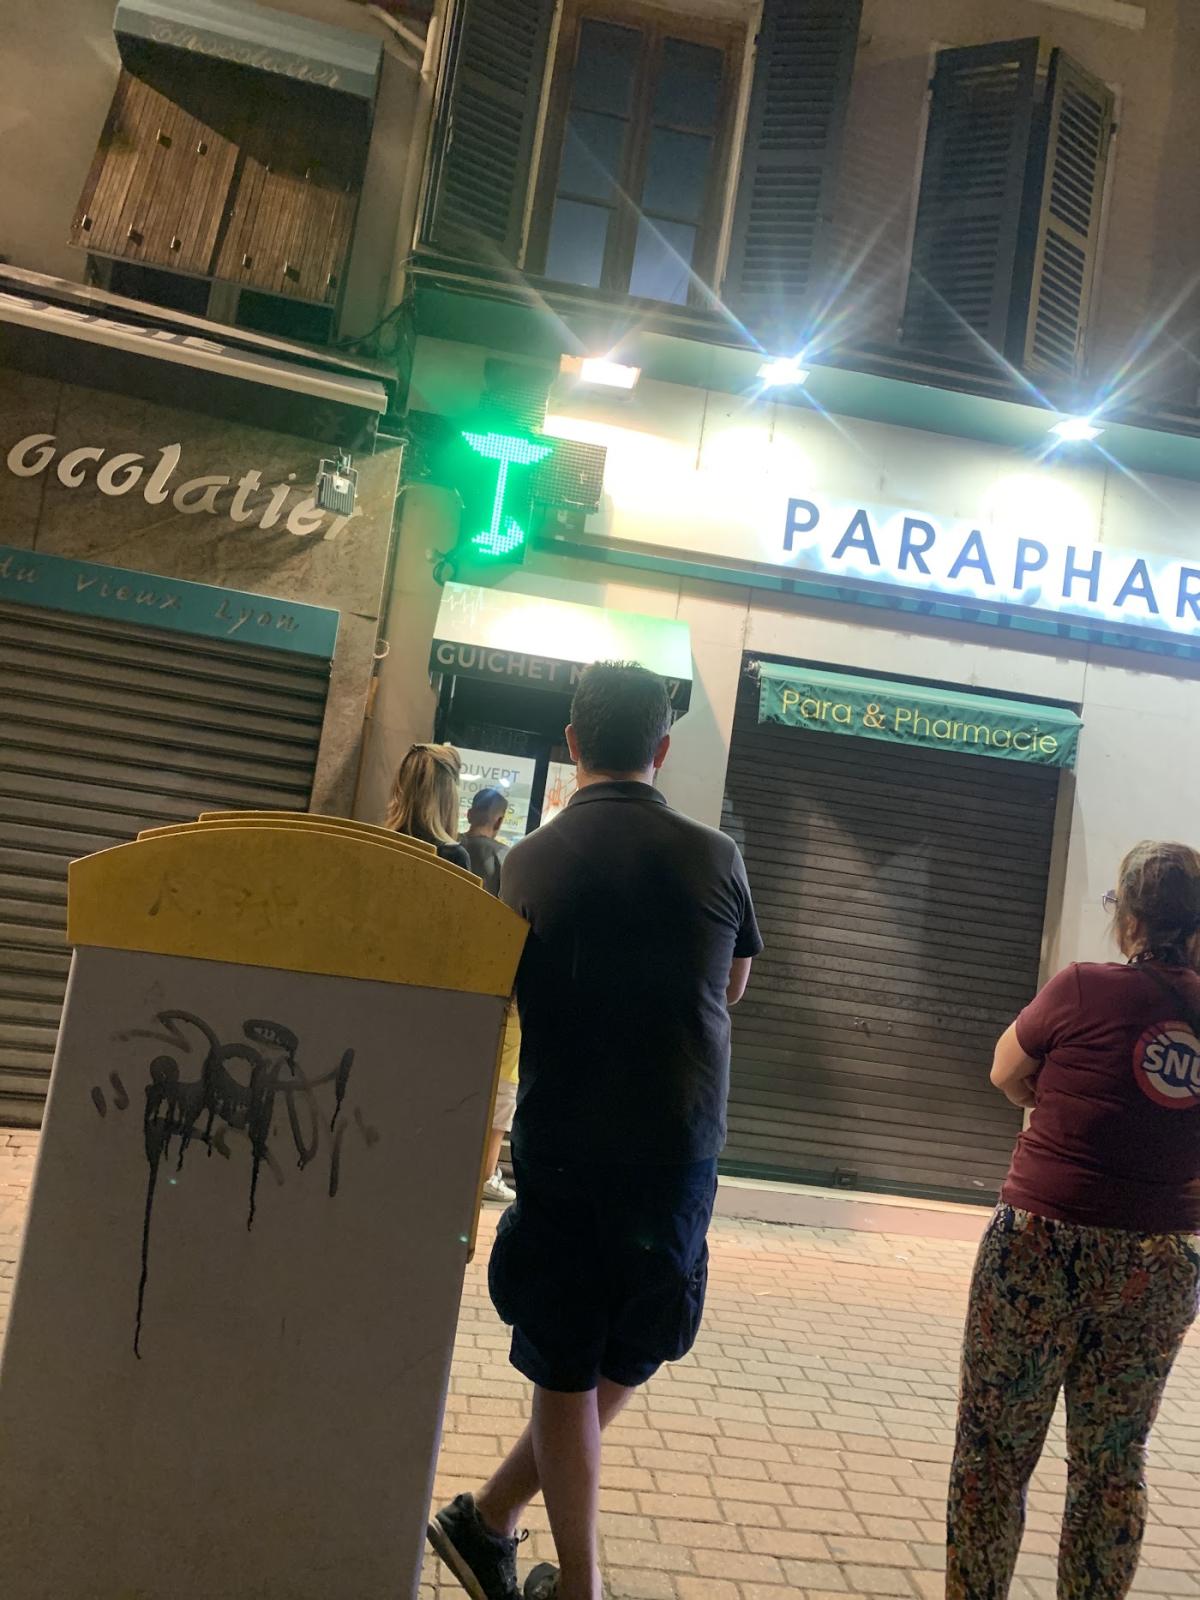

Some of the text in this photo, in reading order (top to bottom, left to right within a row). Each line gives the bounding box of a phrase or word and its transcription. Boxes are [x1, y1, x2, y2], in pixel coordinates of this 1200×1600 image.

[783, 497, 1200, 621] PARAPHAR
[75, 572, 181, 610] Vieux
[214, 598, 300, 634] Lyon
[436, 642, 561, 682] GUICHET
[781, 690, 1058, 755] Para & Pharmacie
